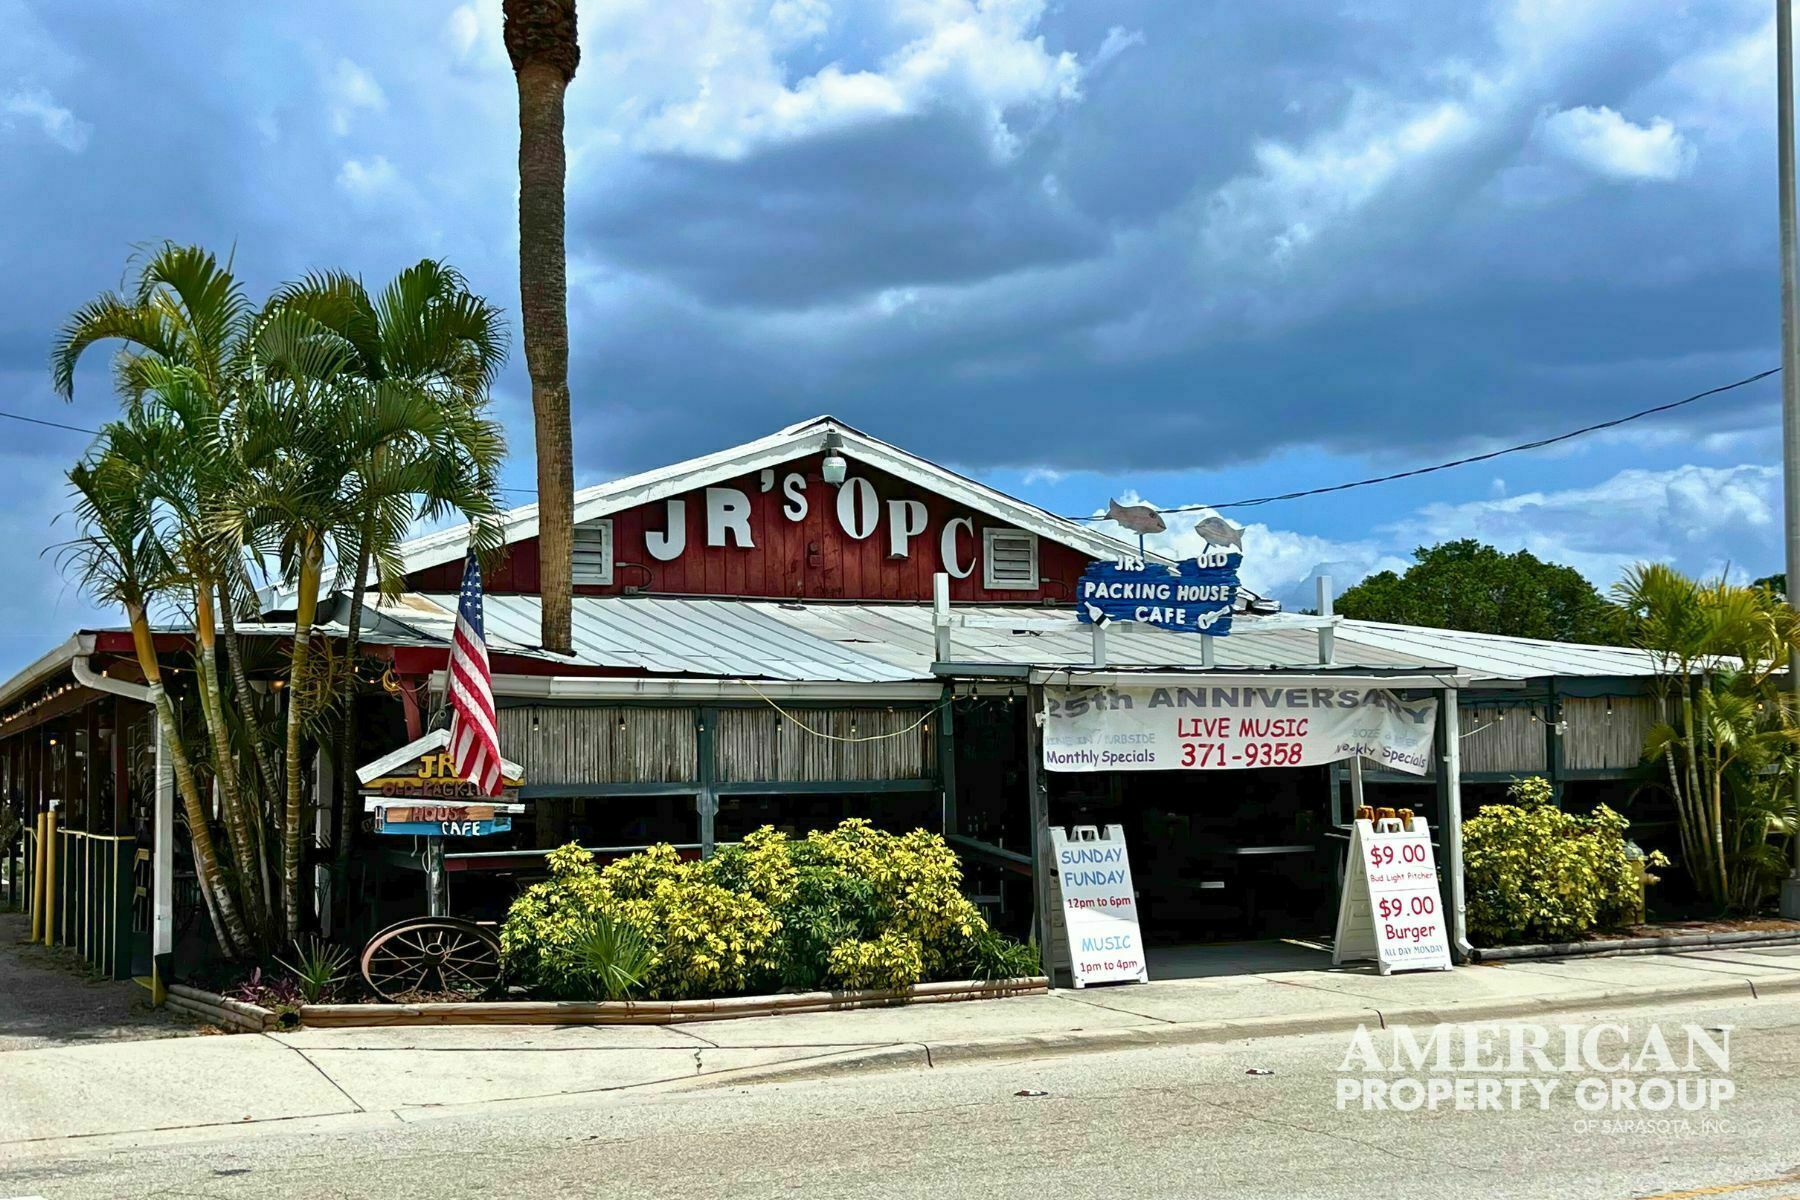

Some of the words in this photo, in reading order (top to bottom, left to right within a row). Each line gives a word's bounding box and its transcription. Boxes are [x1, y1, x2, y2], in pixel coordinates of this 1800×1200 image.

[837, 477, 977, 579] OPC
[1114, 555, 1146, 572] JRS
[1197, 553, 1228, 568] OLD
[1084, 582, 1171, 600] PACKING
[1177, 585, 1230, 601] HOUSE
[1135, 606, 1186, 624] CAFE
[1048, 688, 1134, 718] 25th
[1177, 717, 1231, 738] LIVE
[1239, 718, 1309, 738] MUSIC
[1046, 749, 1100, 767] Monthly
[1101, 748, 1156, 766] Specials
[1180, 742, 1303, 768] 371-9358
[1382, 745, 1427, 768] Specials
[382, 781, 416, 797] OLD
[441, 821, 480, 836] CAFE
[1061, 847, 1122, 865] SUNDAY
[1370, 844, 1426, 868] $9.00
[1064, 870, 1125, 887] FUNDAY
[1370, 874, 1384, 882] Bud
[1386, 873, 1405, 883] Light
[1407, 871, 1435, 880] Pitcher
[1067, 897, 1096, 910] 12pm
[1097, 897, 1107, 907] to
[1109, 895, 1132, 909] 6pm
[1378, 895, 1435, 920] $9.00
[1385, 924, 1436, 942] Burger
[1081, 935, 1132, 952] MUSIC
[1384, 948, 1396, 957] ALL
[1398, 947, 1412, 956] DAY
[1413, 945, 1444, 955] MONDAY
[1080, 962, 1102, 974] 1pm
[1104, 961, 1114, 971] to
[1116, 959, 1138, 972] 4pm
